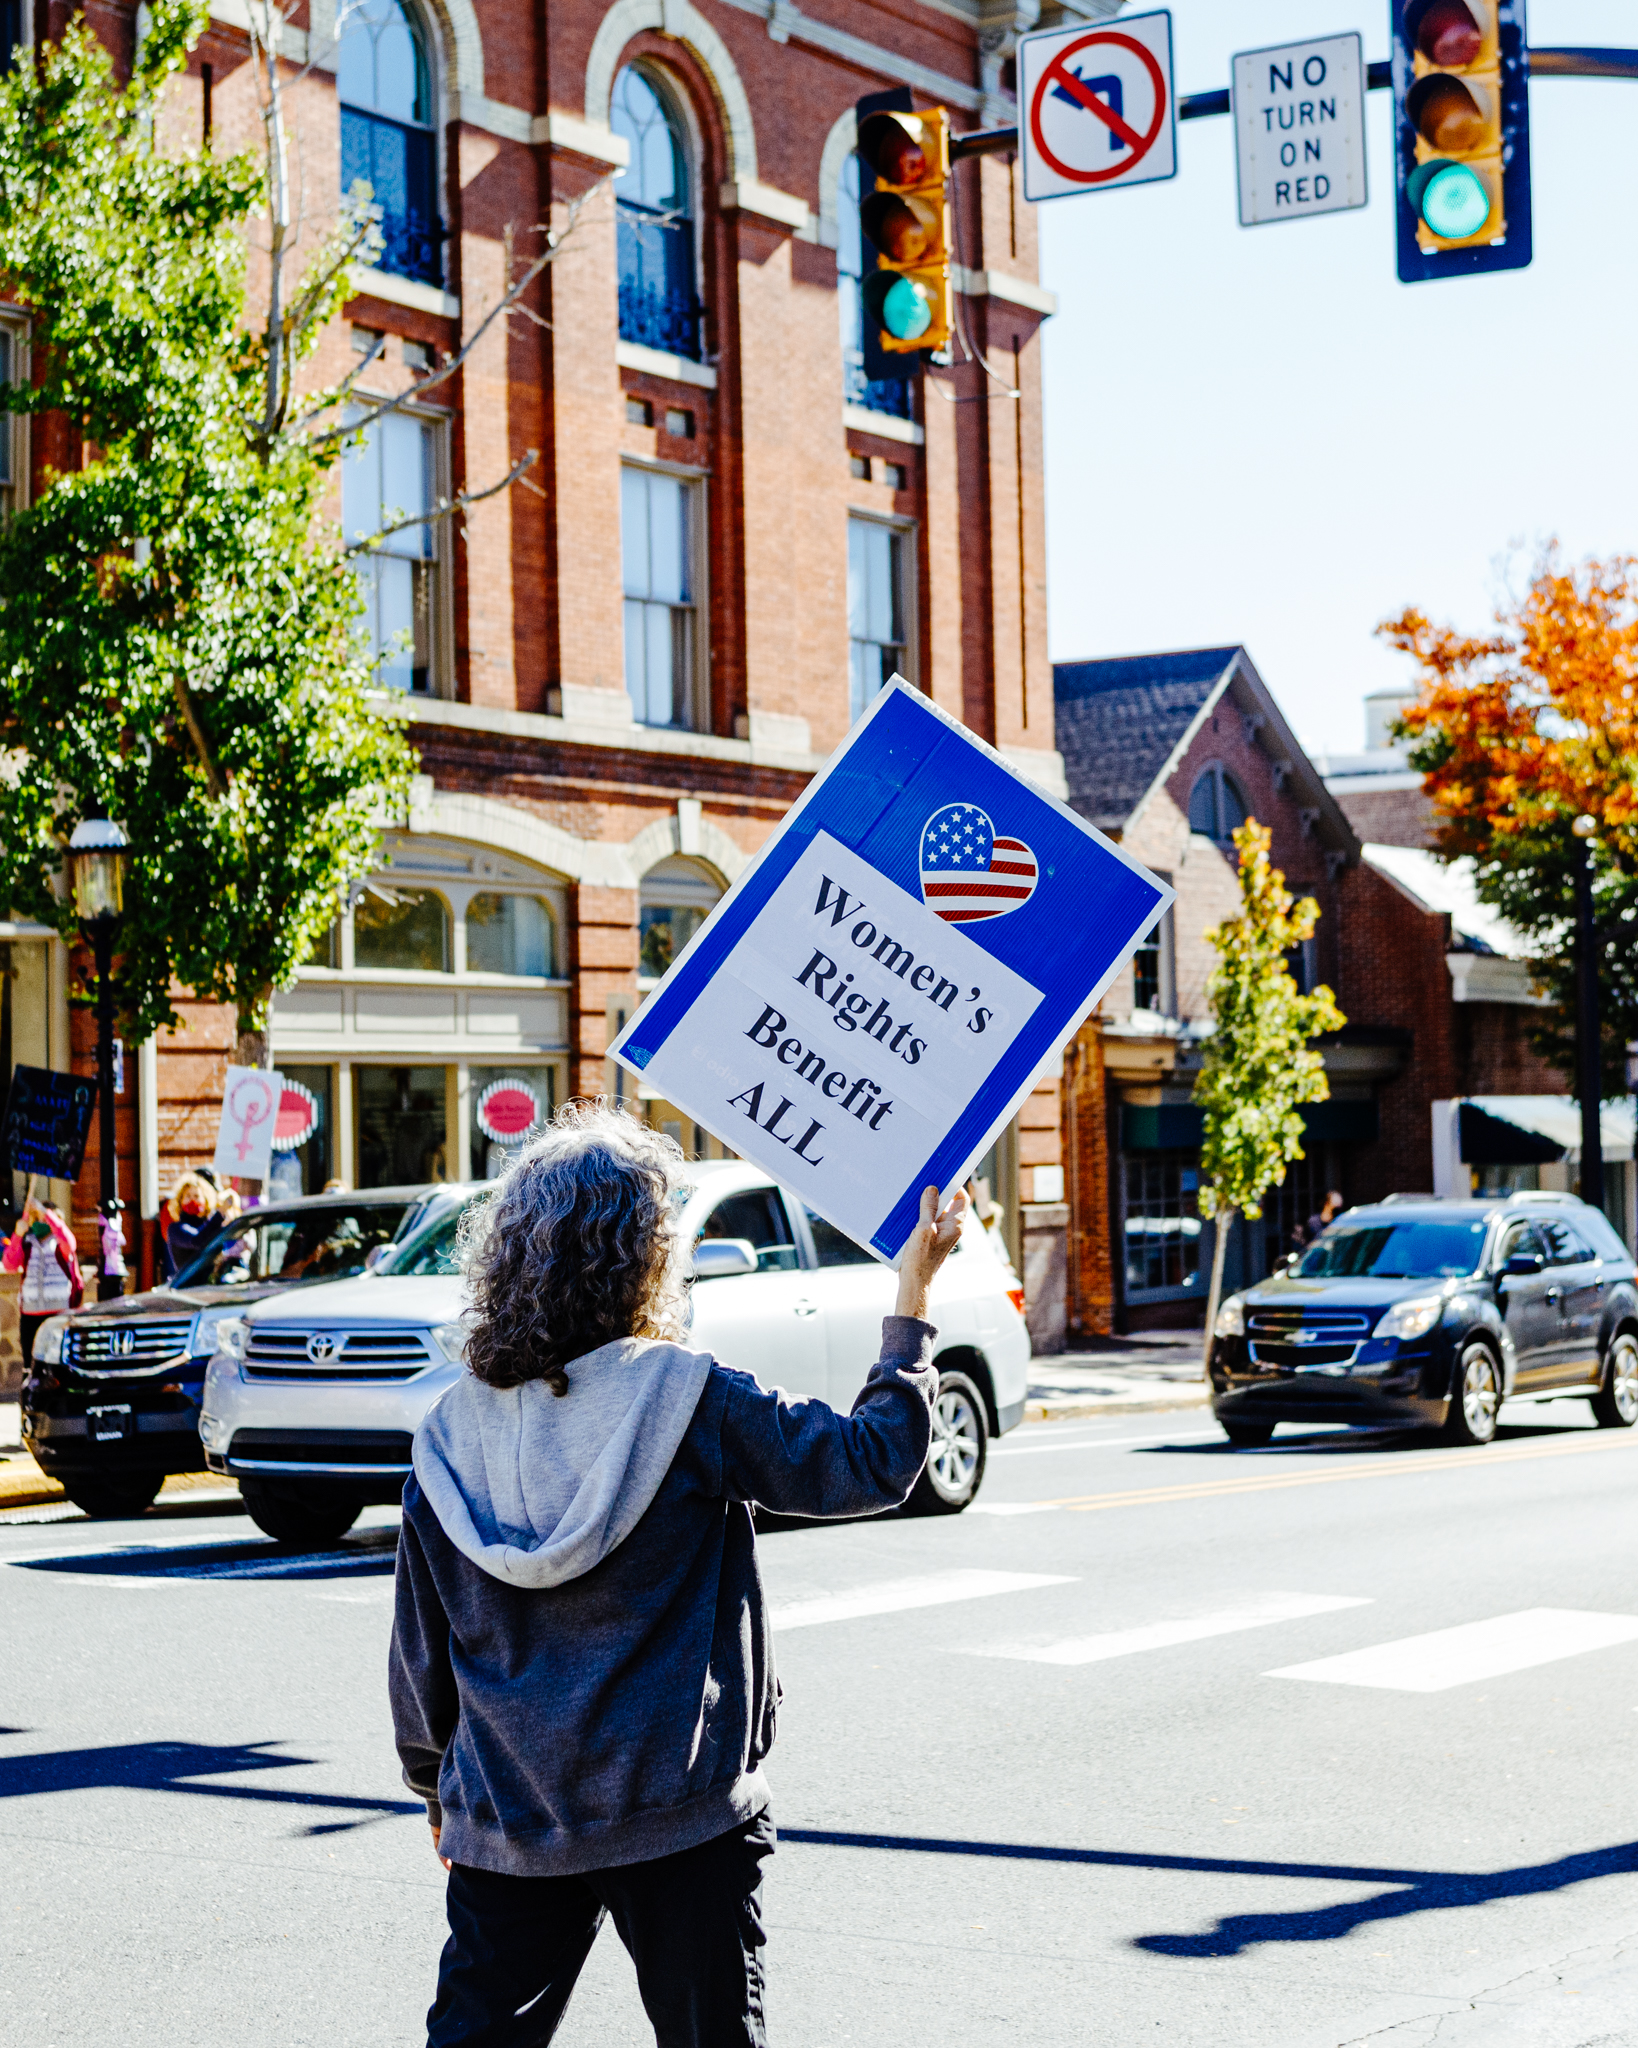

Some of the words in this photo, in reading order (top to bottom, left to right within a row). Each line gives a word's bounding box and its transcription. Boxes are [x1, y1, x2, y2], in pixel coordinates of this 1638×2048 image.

[1269, 56, 1327, 93] NO
[1262, 98, 1336, 132] TURN
[1280, 138, 1321, 167] ON
[1275, 174, 1331, 206] RED
[814, 874, 993, 1033] Women's
[793, 947, 928, 1064] Rights
[744, 1003, 893, 1130] Benefit
[726, 1081, 826, 1166] ALL
